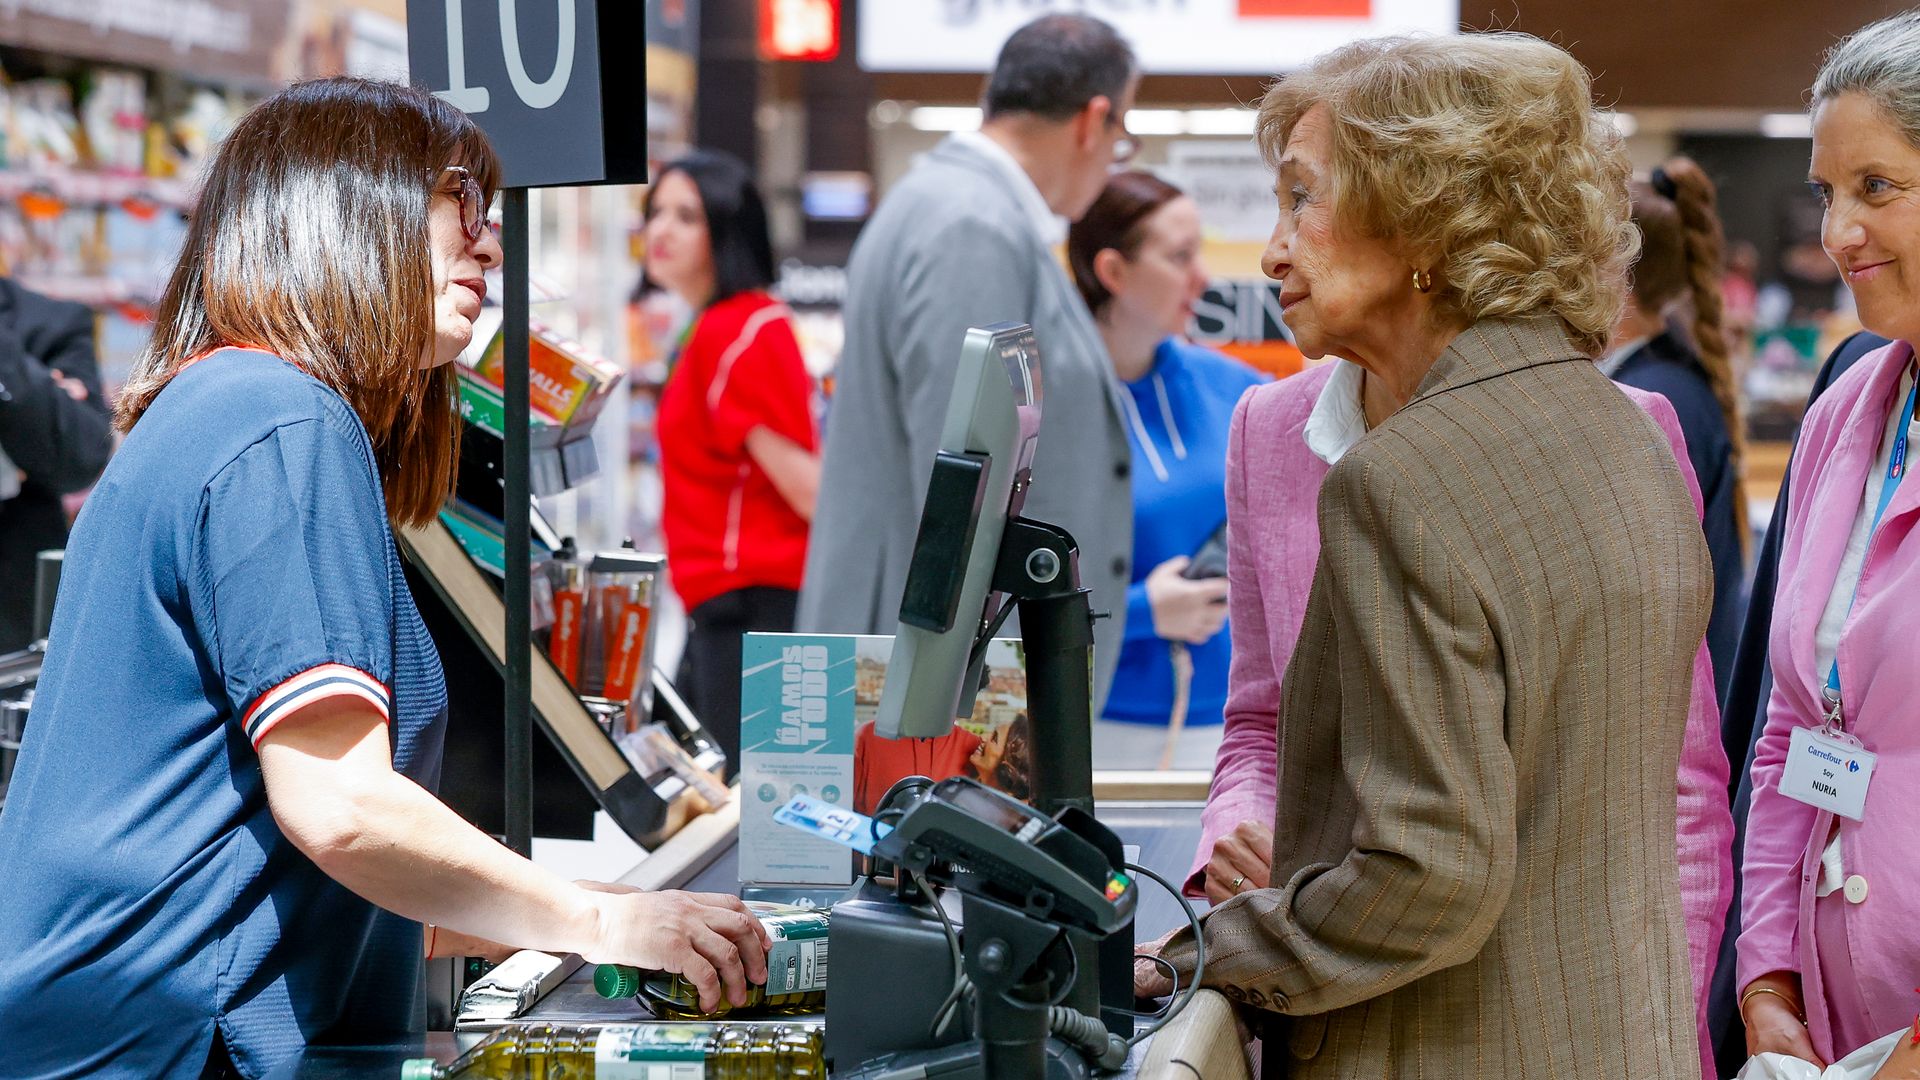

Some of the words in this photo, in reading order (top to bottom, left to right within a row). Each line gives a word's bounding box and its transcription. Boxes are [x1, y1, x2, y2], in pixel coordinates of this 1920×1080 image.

[430, 0, 576, 113] 10
[530, 368, 574, 406] ALLS
[781, 645, 801, 745] DAMOS
[801, 645, 827, 745] TODO
[1808, 745, 1842, 765] Carrefour
[1822, 768, 1835, 780] Soy
[1812, 780, 1837, 798] NURIA
